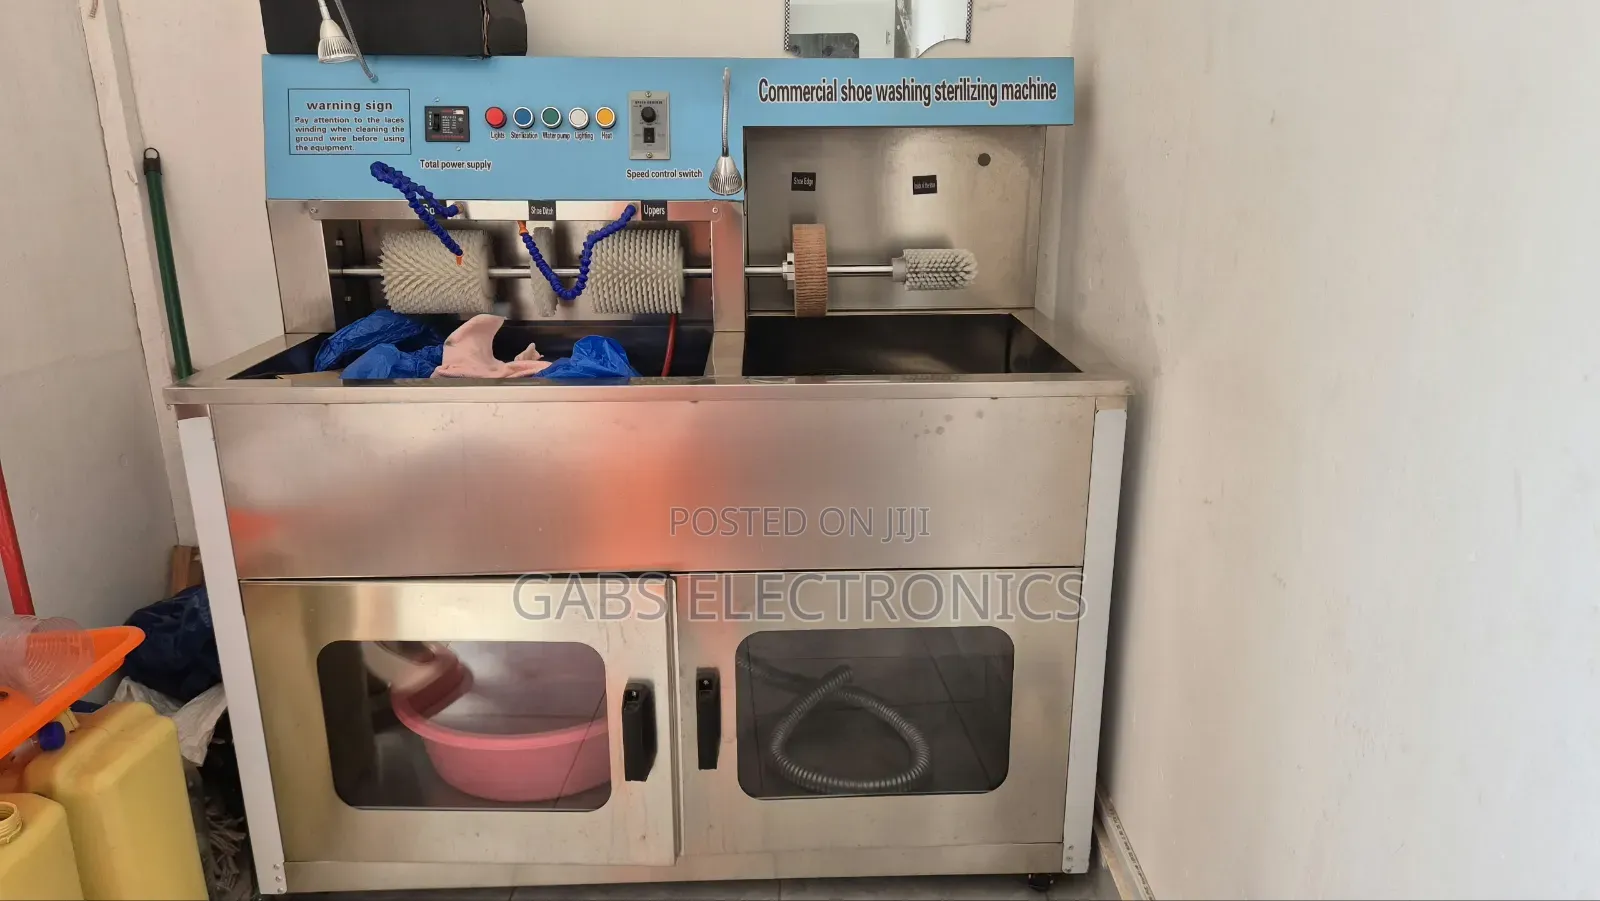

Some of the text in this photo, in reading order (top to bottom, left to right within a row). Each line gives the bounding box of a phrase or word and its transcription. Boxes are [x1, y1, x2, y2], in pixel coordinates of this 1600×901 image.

[758, 76, 1057, 107] Commercial shoe washing sterilizing machine
[306, 100, 393, 112] warning sign
[295, 126, 327, 134] winding
[356, 126, 389, 134] cleaning
[296, 135, 324, 143] ground
[384, 135, 405, 143] using
[310, 144, 354, 153] equipment.
[420, 159, 492, 171] Total power supply
[626, 169, 703, 180] Speed control switch
[530, 206, 542, 214] Shoe
[644, 205, 665, 216] Uppers
